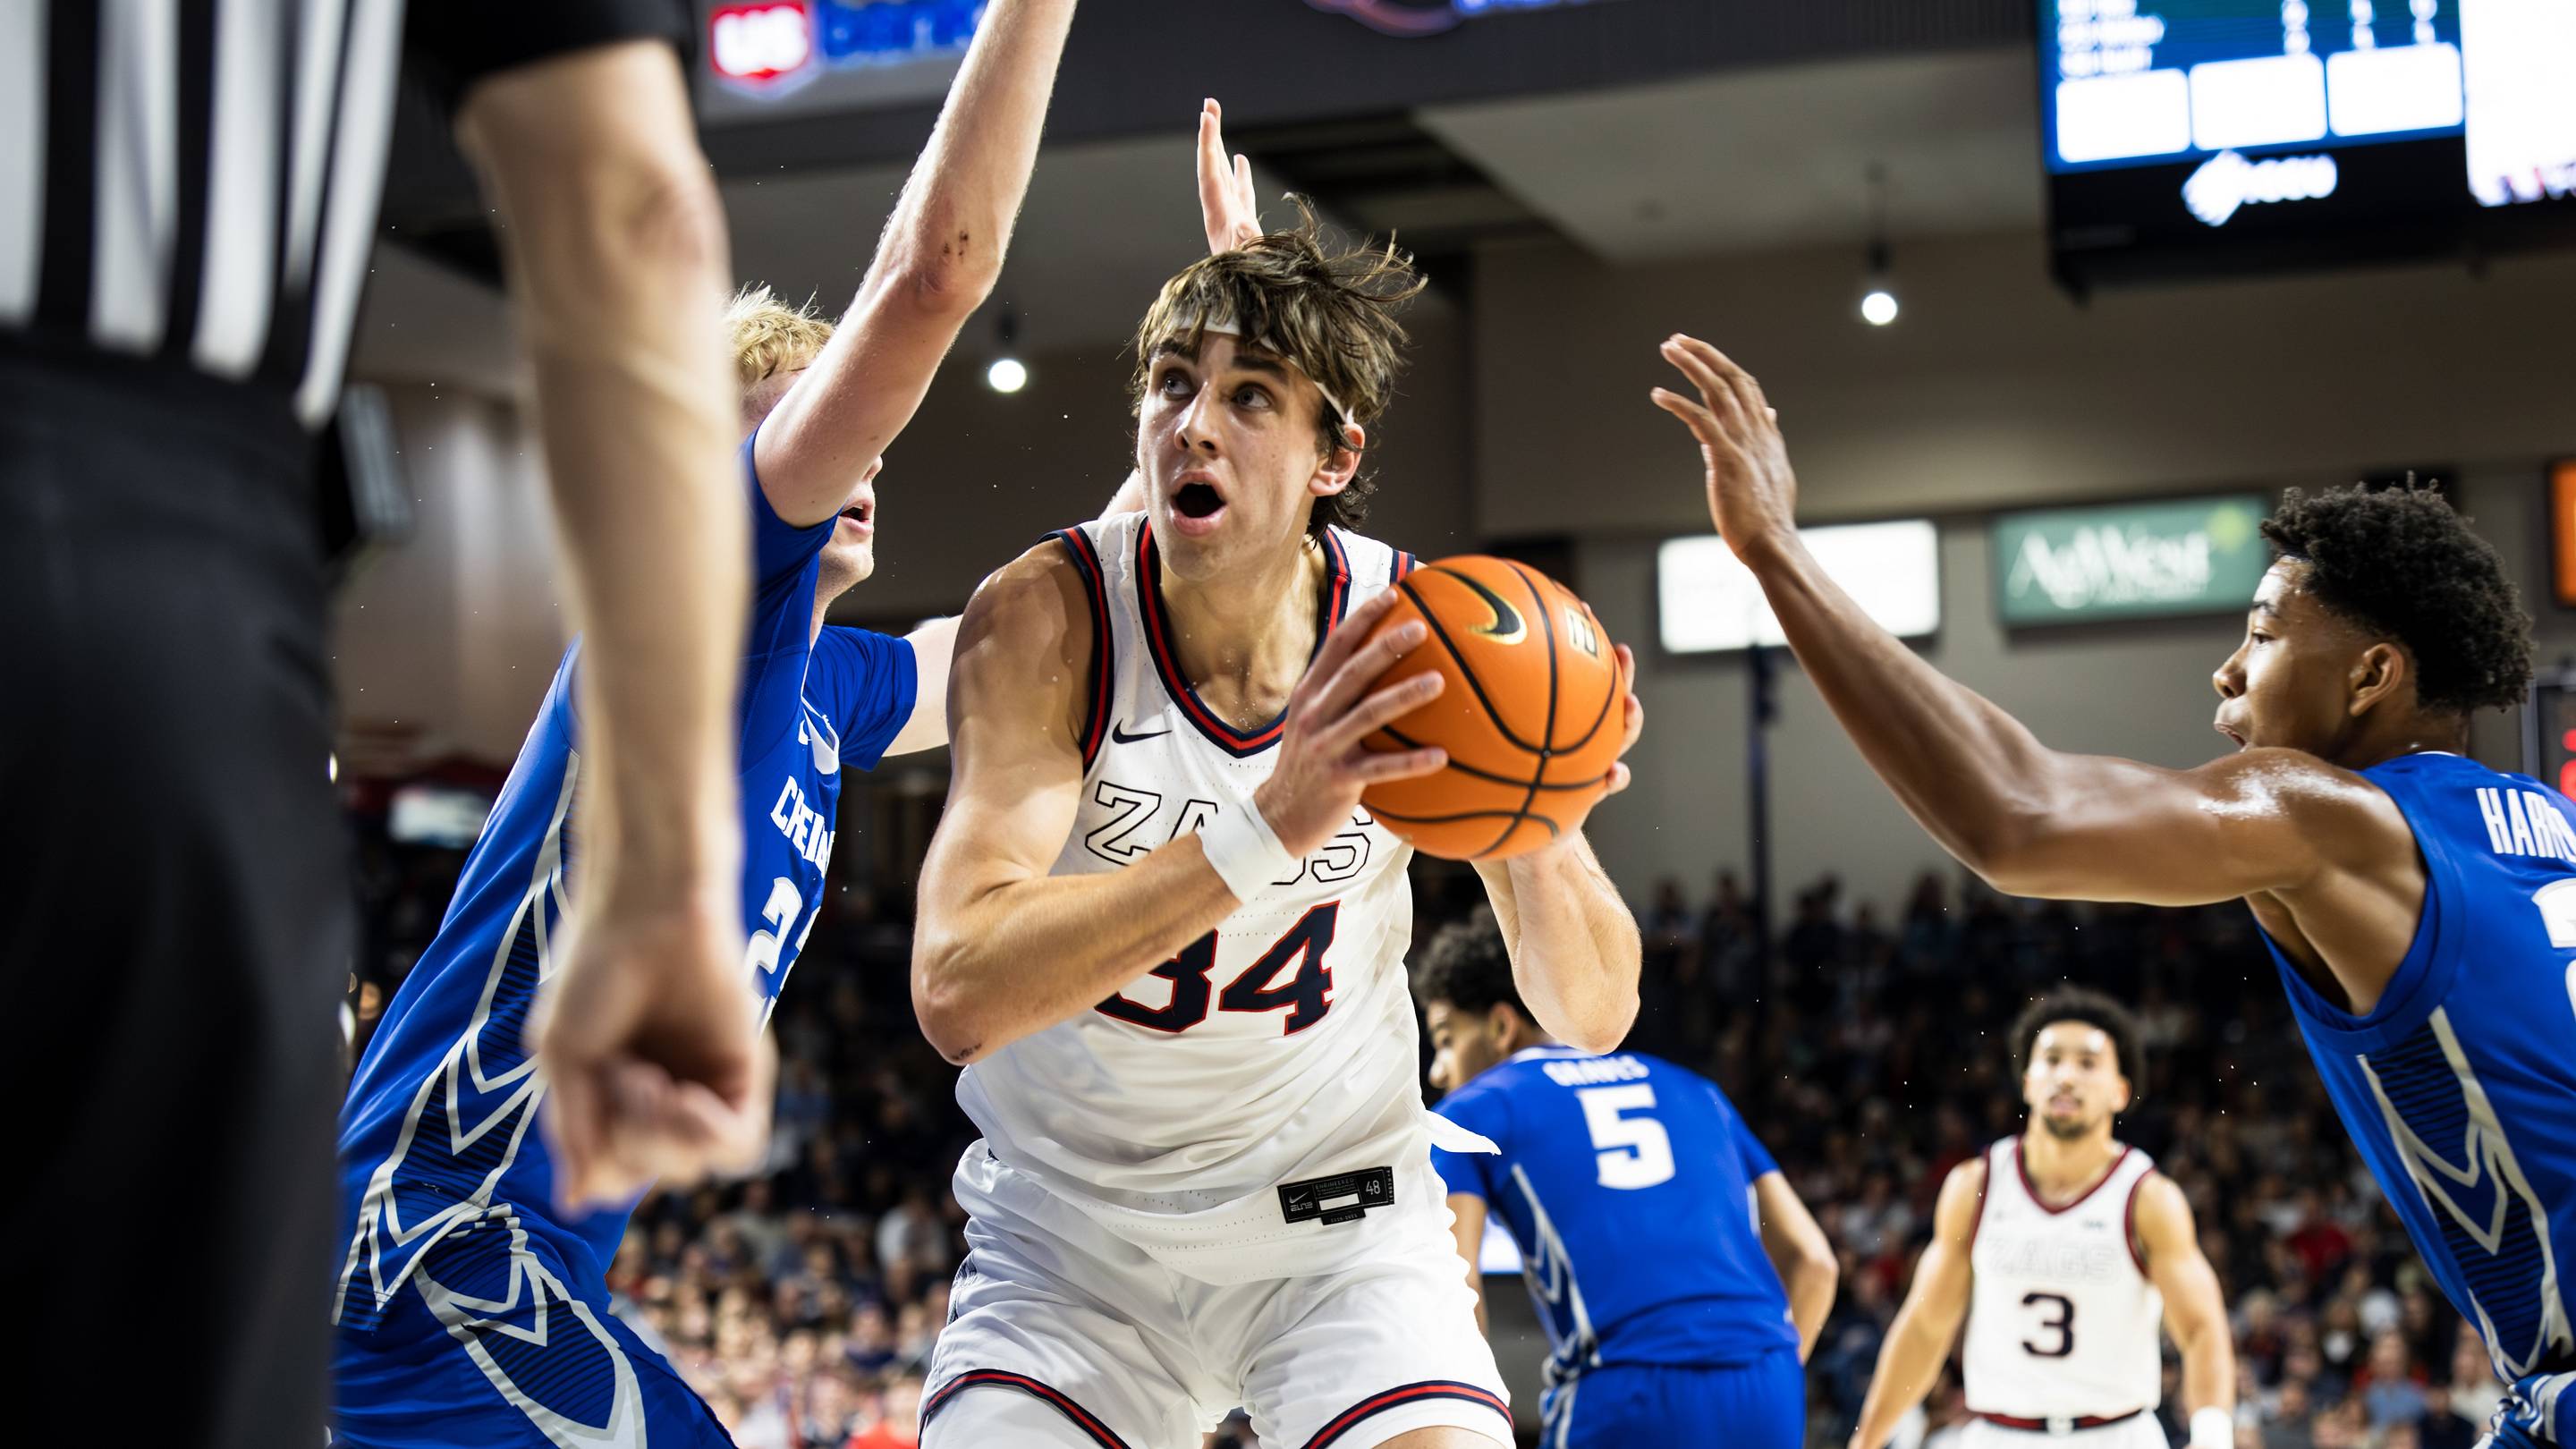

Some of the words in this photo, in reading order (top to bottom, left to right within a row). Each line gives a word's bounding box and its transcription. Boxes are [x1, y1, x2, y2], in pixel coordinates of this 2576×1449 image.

[1085, 780, 1372, 884] ZAS
[1094, 899, 1342, 1037] 34
[1365, 1180, 1381, 1195] 48
[1574, 1082, 1676, 1191] 5
[2021, 1291, 2076, 1359] 3
